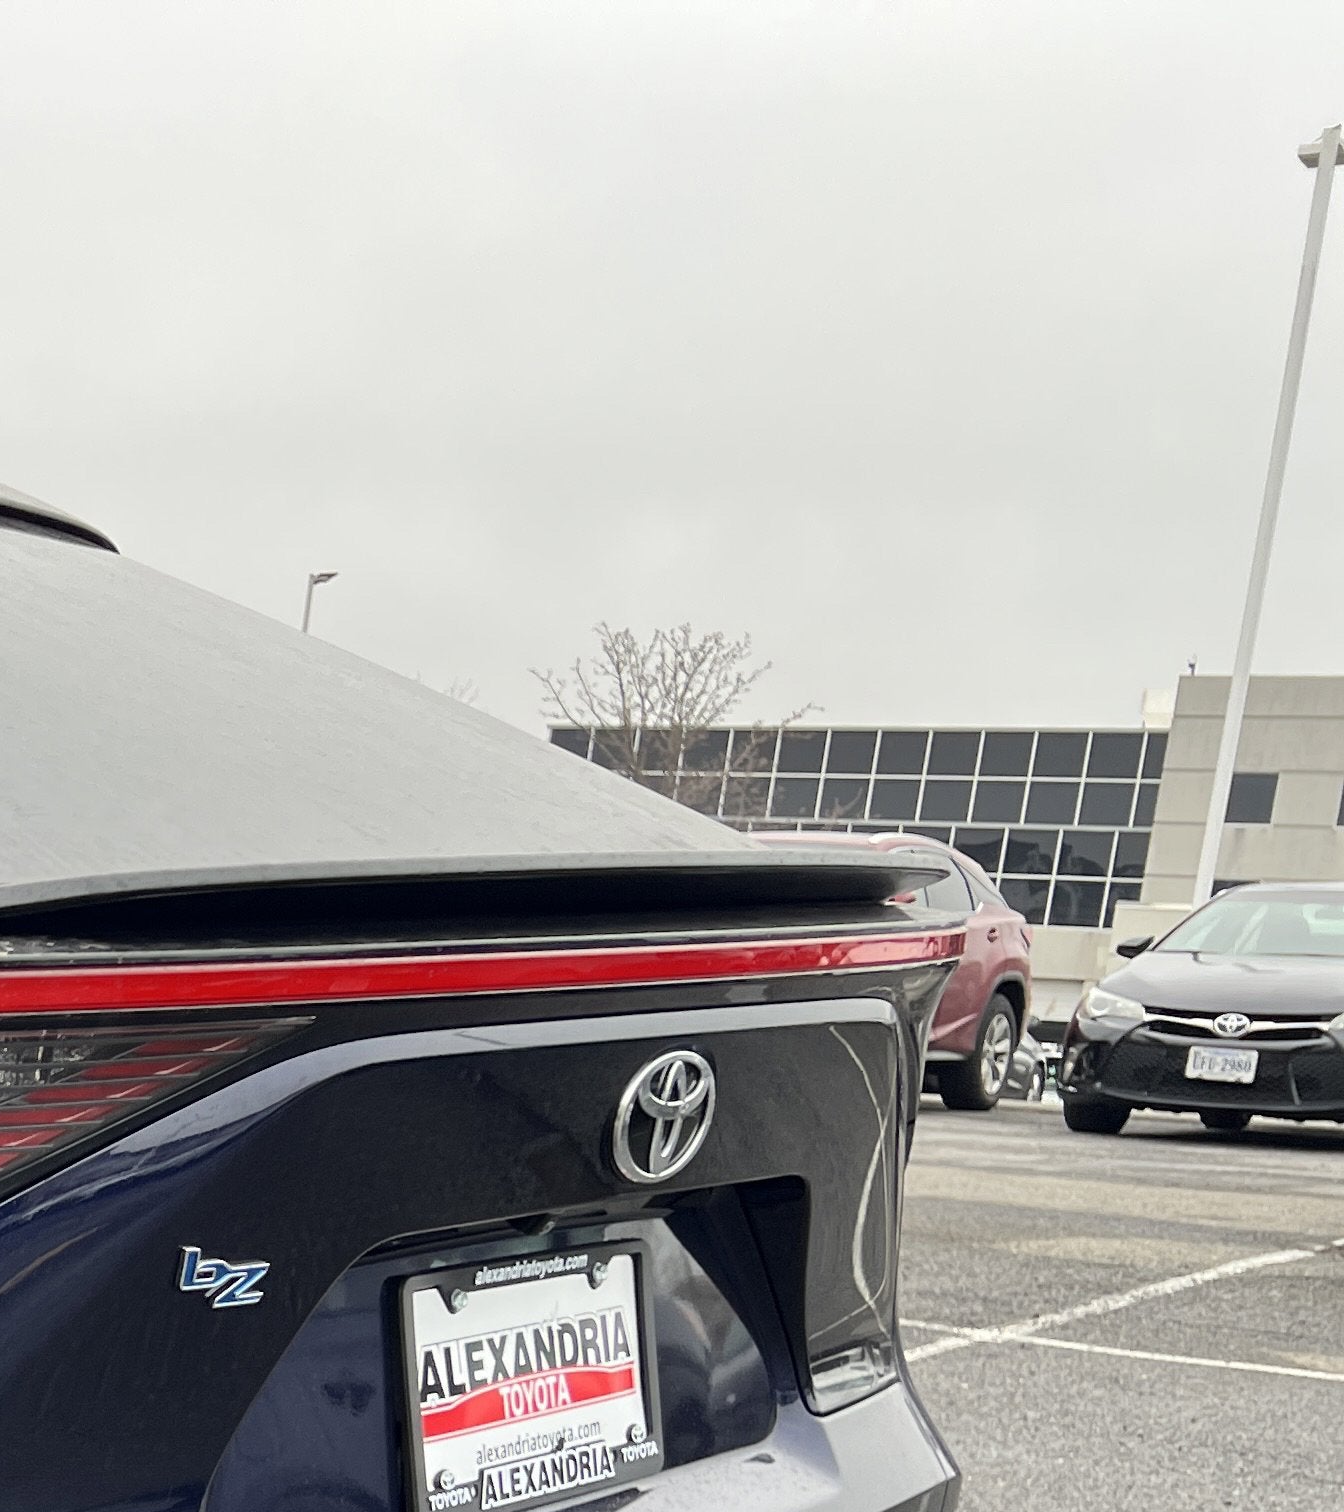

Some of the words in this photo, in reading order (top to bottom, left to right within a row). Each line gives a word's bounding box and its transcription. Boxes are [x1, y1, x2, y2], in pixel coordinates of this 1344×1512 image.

[475, 1254, 589, 1285] alexandriatoyota.com
[419, 1311, 631, 1400] ALEXANDRIA
[499, 1373, 572, 1419] TOYOTA
[476, 1420, 601, 1465] alexandriatoyota.com
[427, 1487, 473, 1512] TOYOTA
[482, 1445, 614, 1506] ALEXANDRIA
[620, 1440, 659, 1464] TOYOTA
